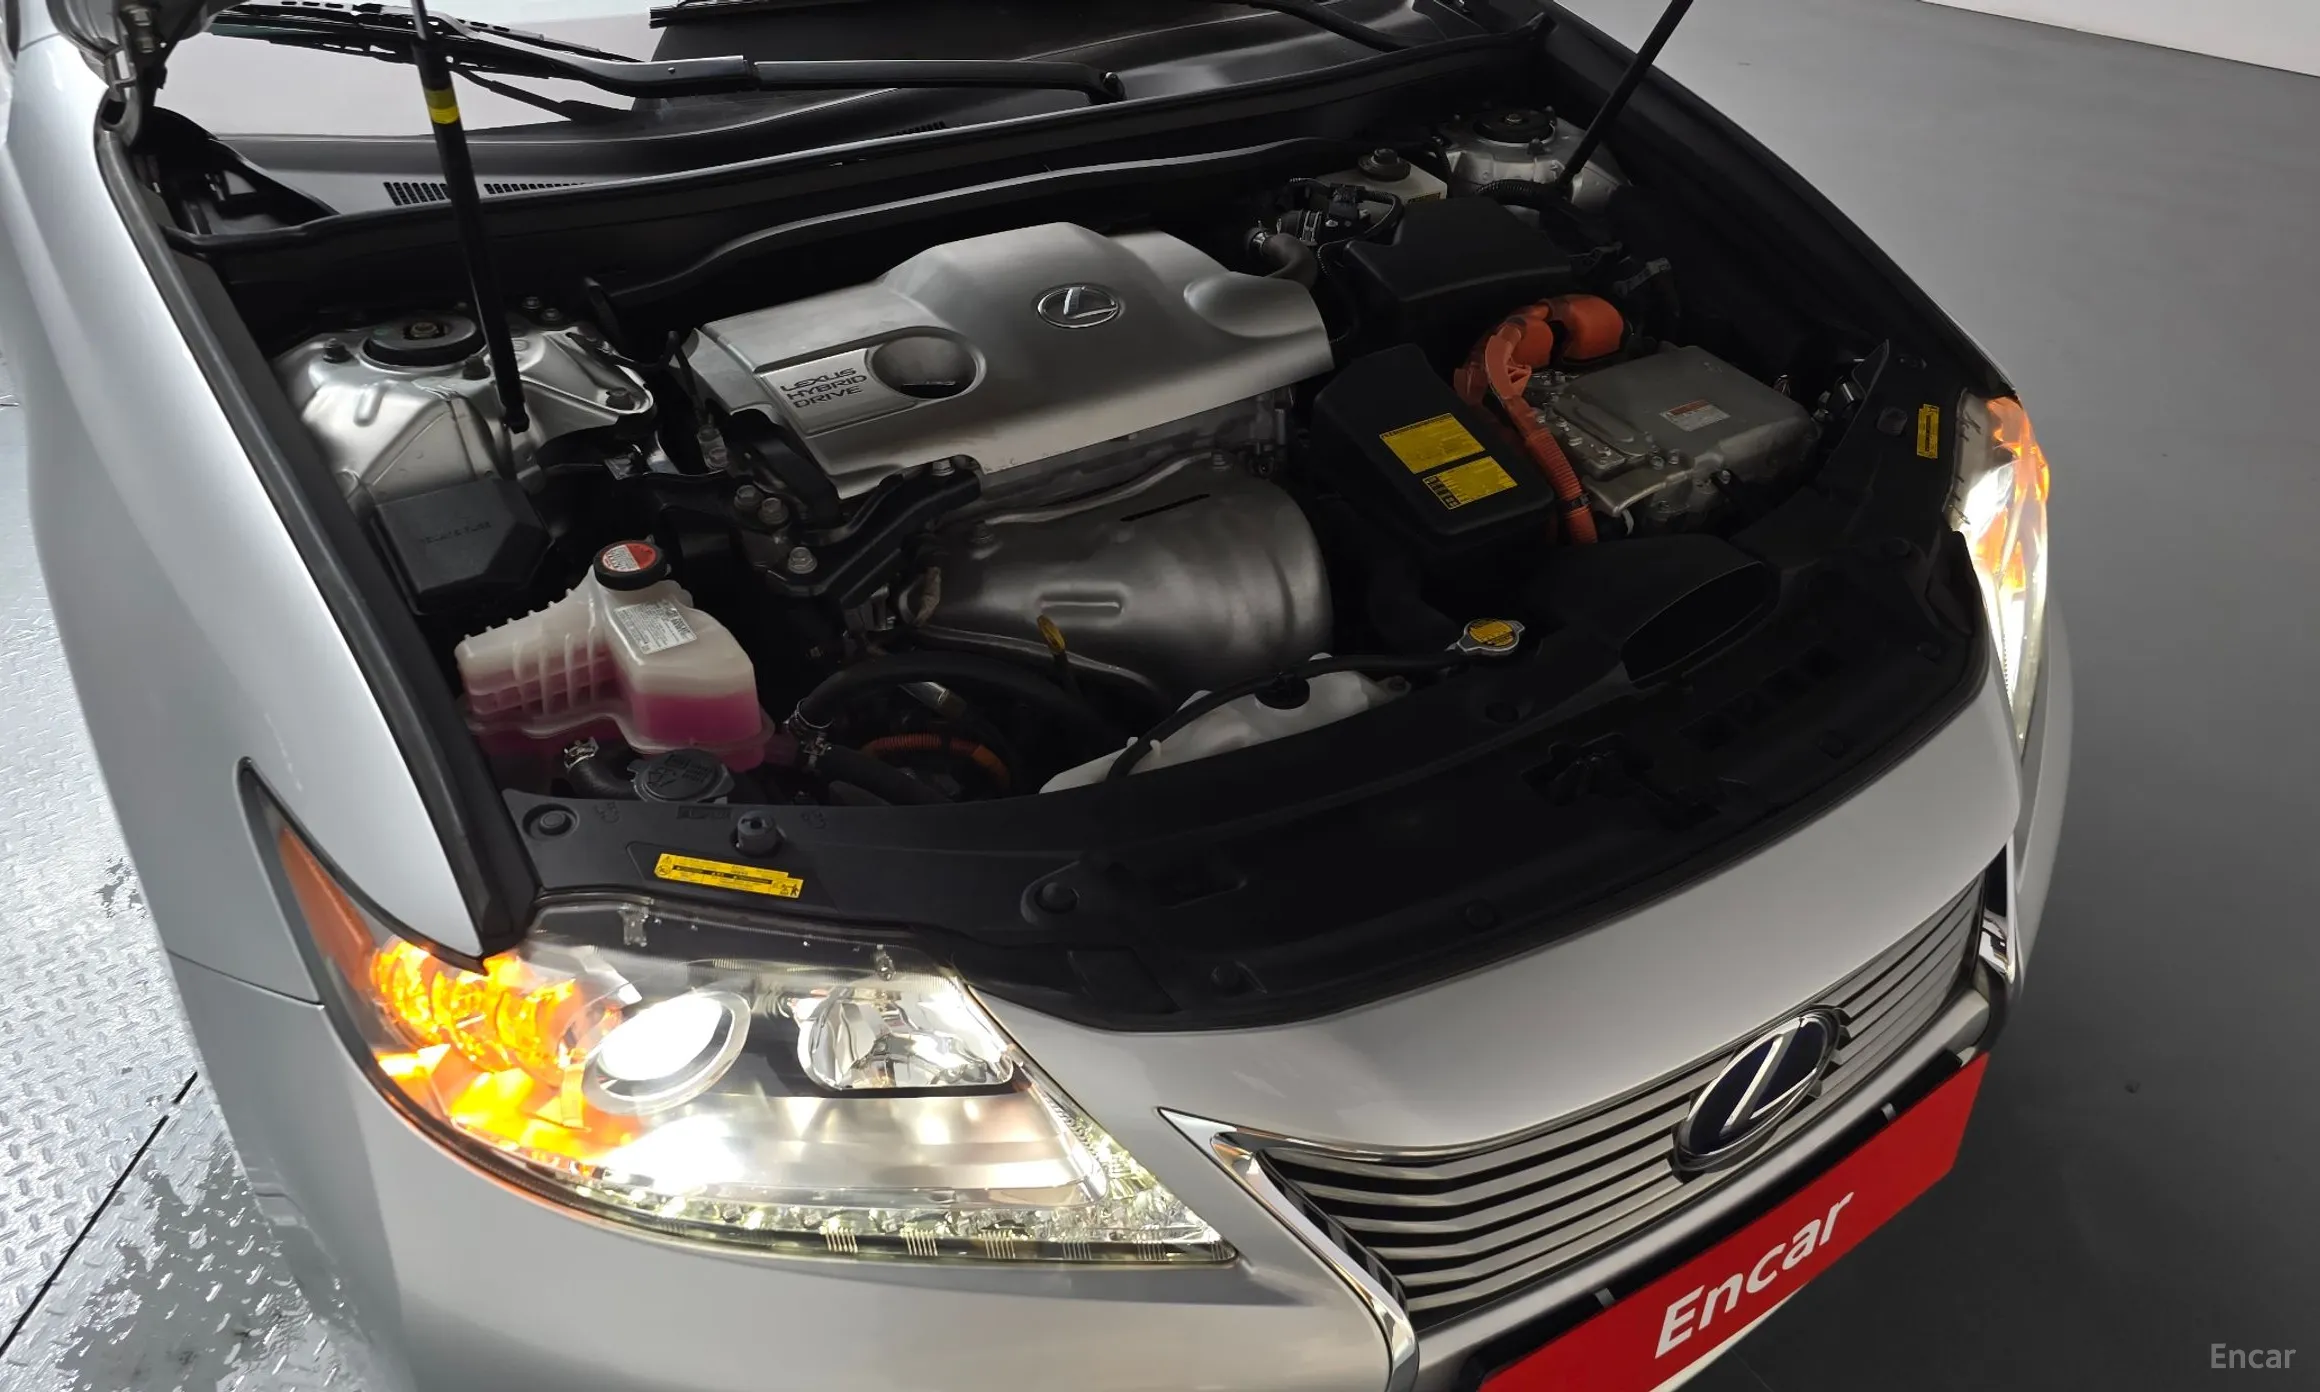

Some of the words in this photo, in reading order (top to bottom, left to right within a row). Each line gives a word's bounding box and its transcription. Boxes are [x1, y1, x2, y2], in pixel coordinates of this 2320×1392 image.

[779, 367, 857, 392] LEXUS
[786, 375, 868, 400] HYBRID
[793, 385, 863, 409] DRIVE
[1654, 1191, 1855, 1360] Encar
